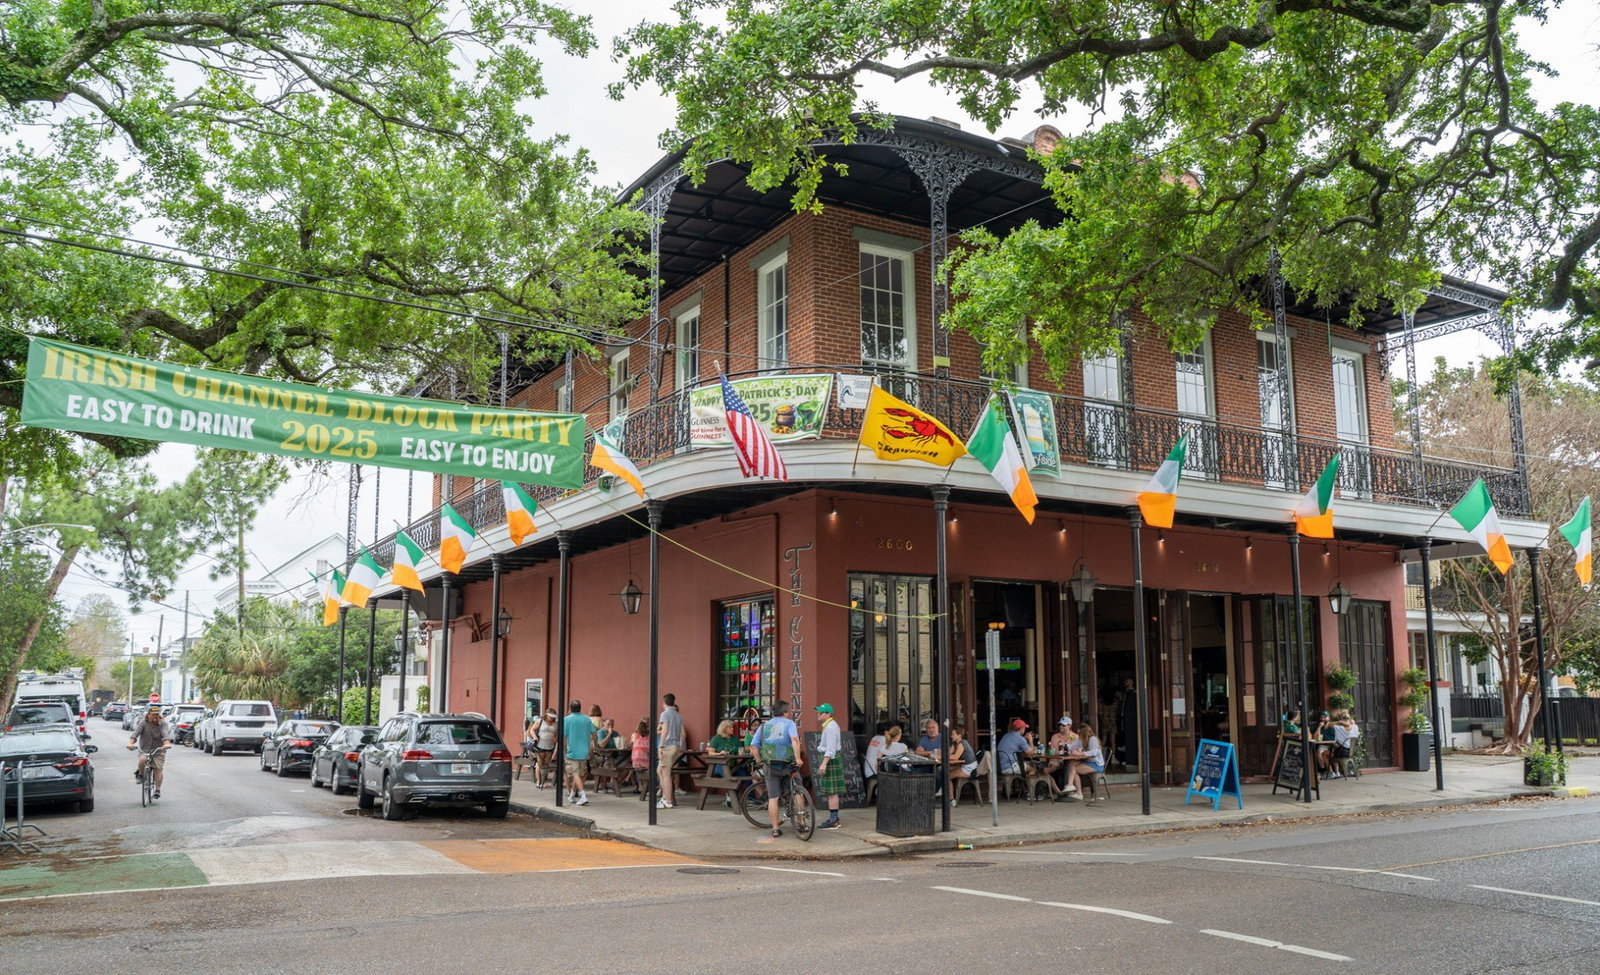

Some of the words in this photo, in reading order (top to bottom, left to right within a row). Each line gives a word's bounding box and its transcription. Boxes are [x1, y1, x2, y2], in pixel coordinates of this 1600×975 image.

[41, 346, 158, 392] IRISH
[172, 371, 334, 417] CHANNEL
[345, 398, 459, 432] BLOCK
[470, 411, 574, 446] PARTY
[66, 394, 135, 424] EASY
[141, 403, 174, 429] TO
[179, 408, 256, 440] DRINK
[694, 395, 722, 407] HAPPY
[796, 385, 818, 396] DAY
[280, 420, 378, 459] 2025
[400, 437, 456, 463] EASY
[461, 443, 487, 467] TO
[492, 447, 556, 475] ENJOY
[788, 615, 804, 746] CHANNE
